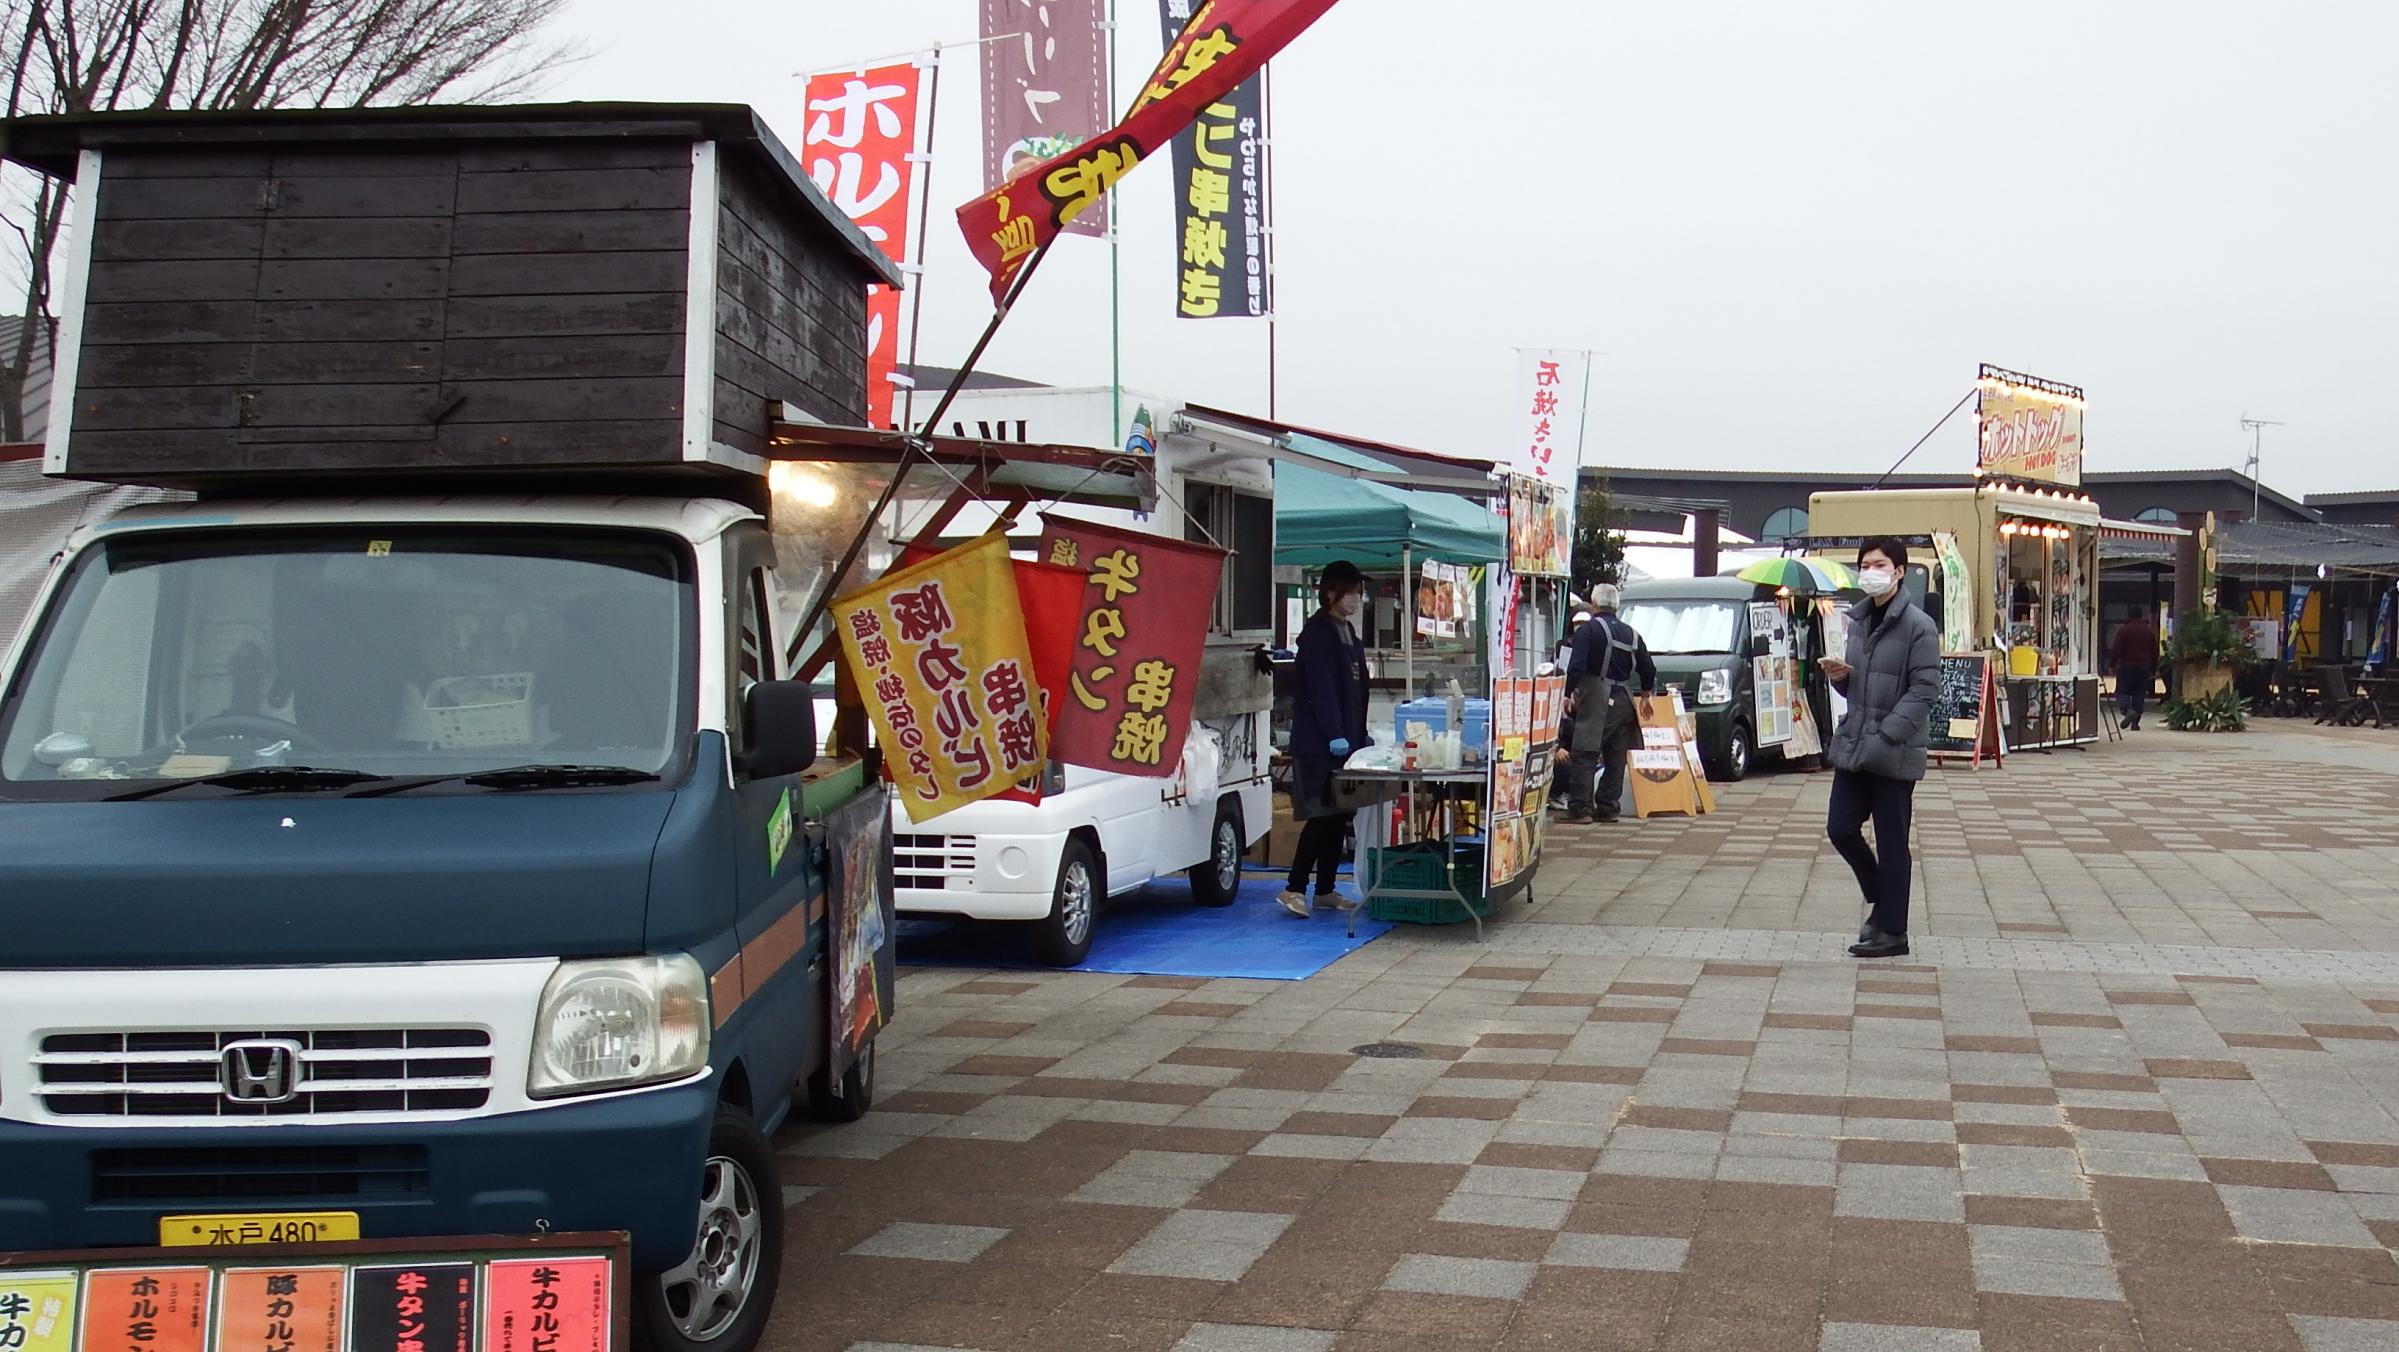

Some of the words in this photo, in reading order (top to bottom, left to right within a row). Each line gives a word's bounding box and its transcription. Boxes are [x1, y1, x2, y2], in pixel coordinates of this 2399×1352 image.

[1982, 404, 2065, 463] ホットドッグ
[1939, 658, 1972, 670] MENU
[209, 1222, 263, 1244] 水戸
[269, 1221, 317, 1244] 480
